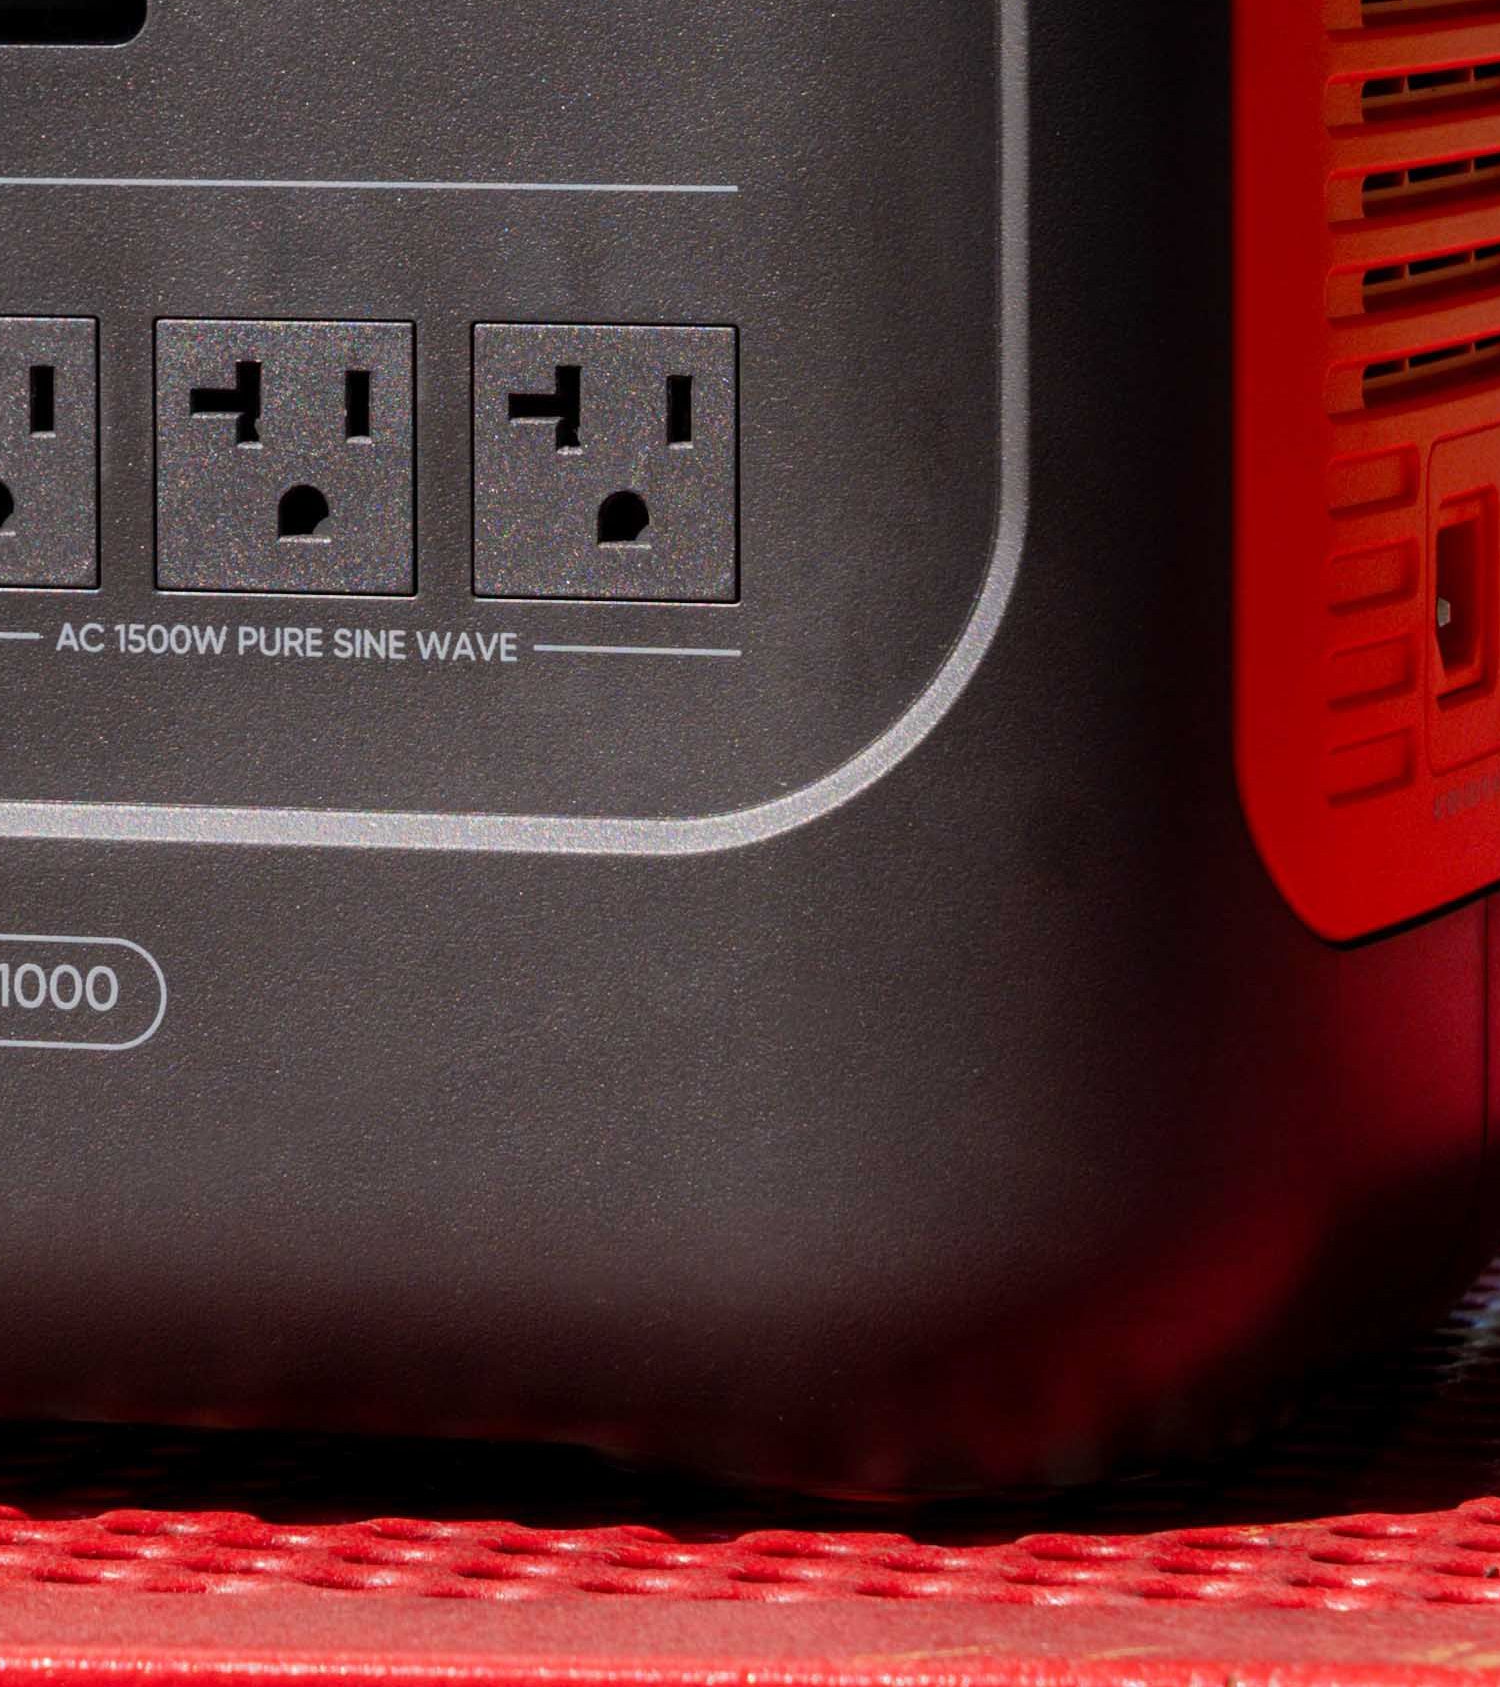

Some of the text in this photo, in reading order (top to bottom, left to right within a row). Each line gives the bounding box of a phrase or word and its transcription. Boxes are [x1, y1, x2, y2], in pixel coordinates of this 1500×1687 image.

[55, 622, 519, 664] AC 1500W PURE SINE WAVE
